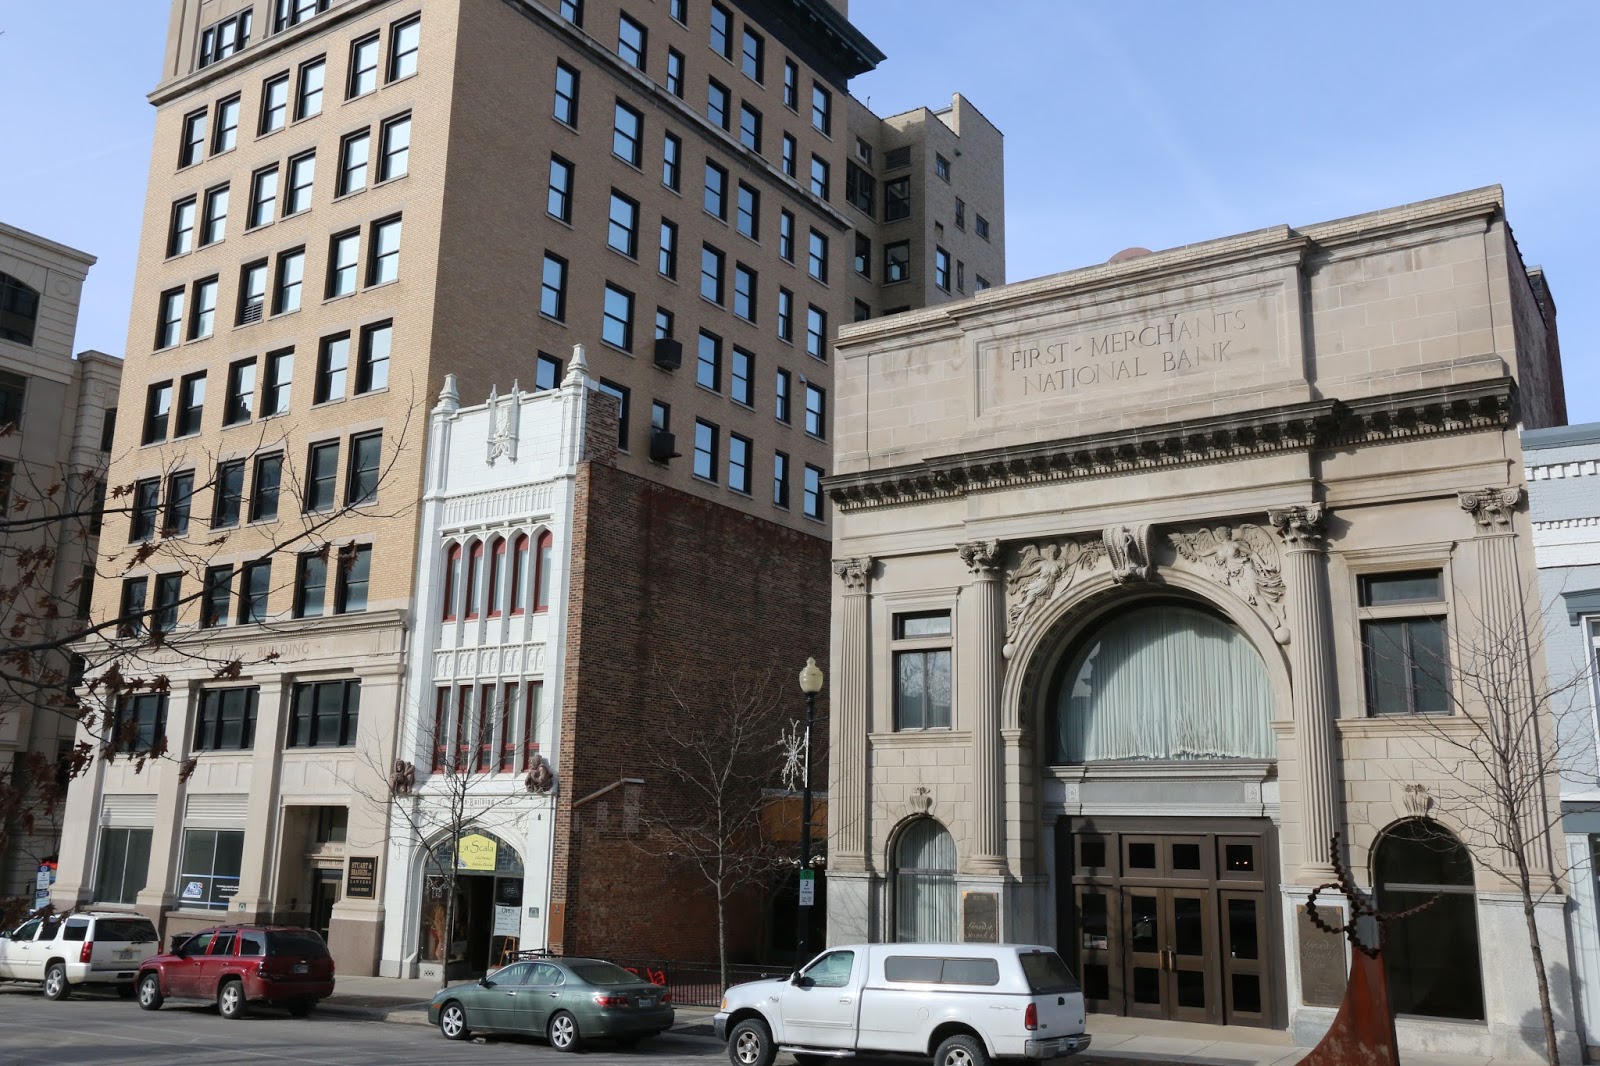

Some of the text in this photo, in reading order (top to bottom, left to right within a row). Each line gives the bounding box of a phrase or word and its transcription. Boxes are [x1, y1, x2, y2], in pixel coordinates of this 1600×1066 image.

[1011, 342, 1070, 371] FIRST
[1090, 309, 1246, 357] MERCHANTS
[1024, 340, 1232, 395] NATIONAL BANK
[470, 840, 494, 853] Scala
